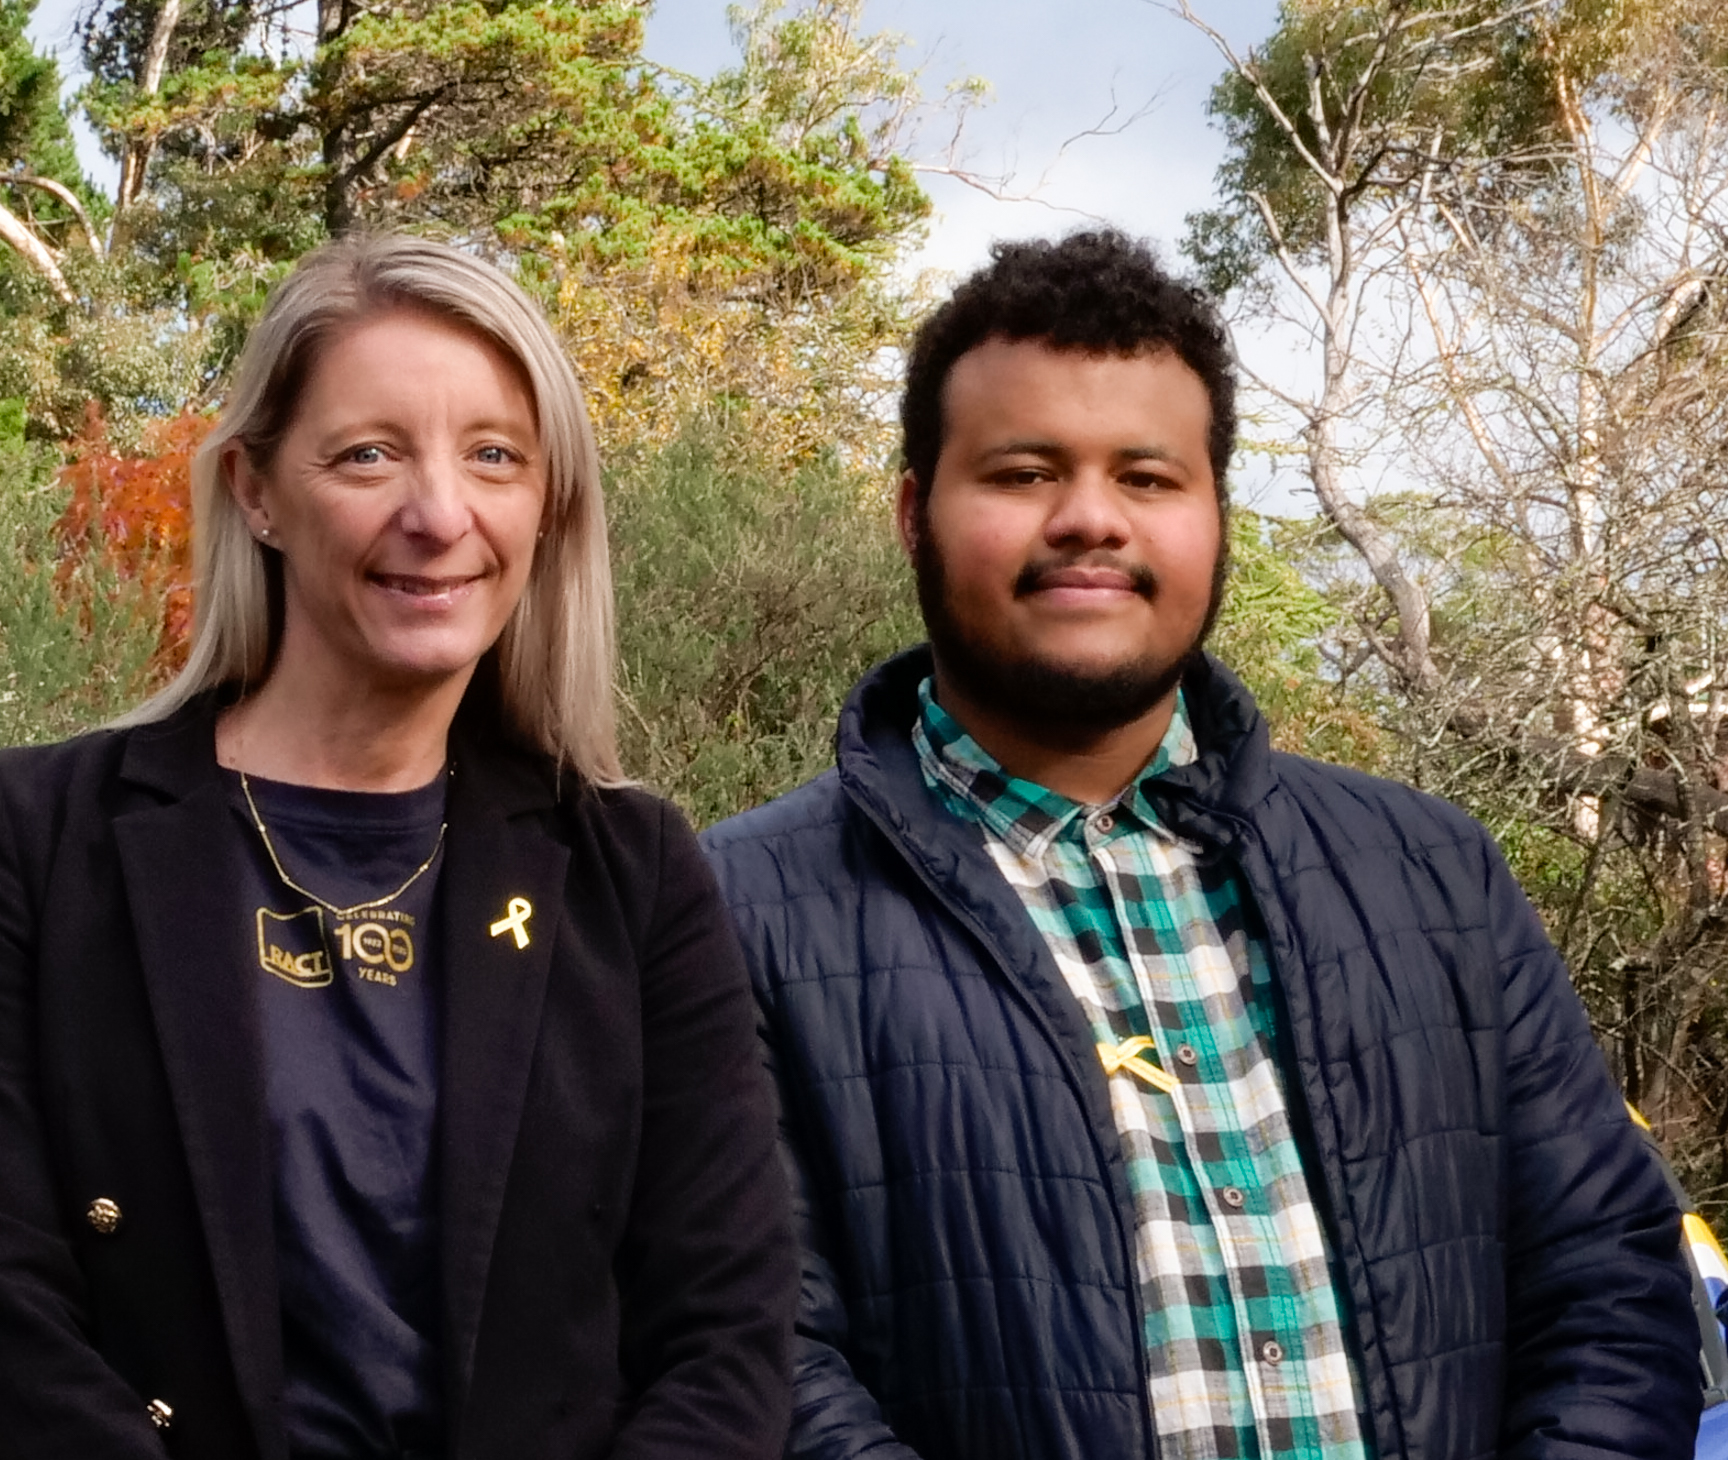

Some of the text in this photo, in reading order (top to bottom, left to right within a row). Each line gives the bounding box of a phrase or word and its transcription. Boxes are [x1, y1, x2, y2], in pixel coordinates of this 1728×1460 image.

[269, 944, 324, 977] RACT
[334, 922, 414, 972] 100
[358, 966, 397, 987] YEARS
